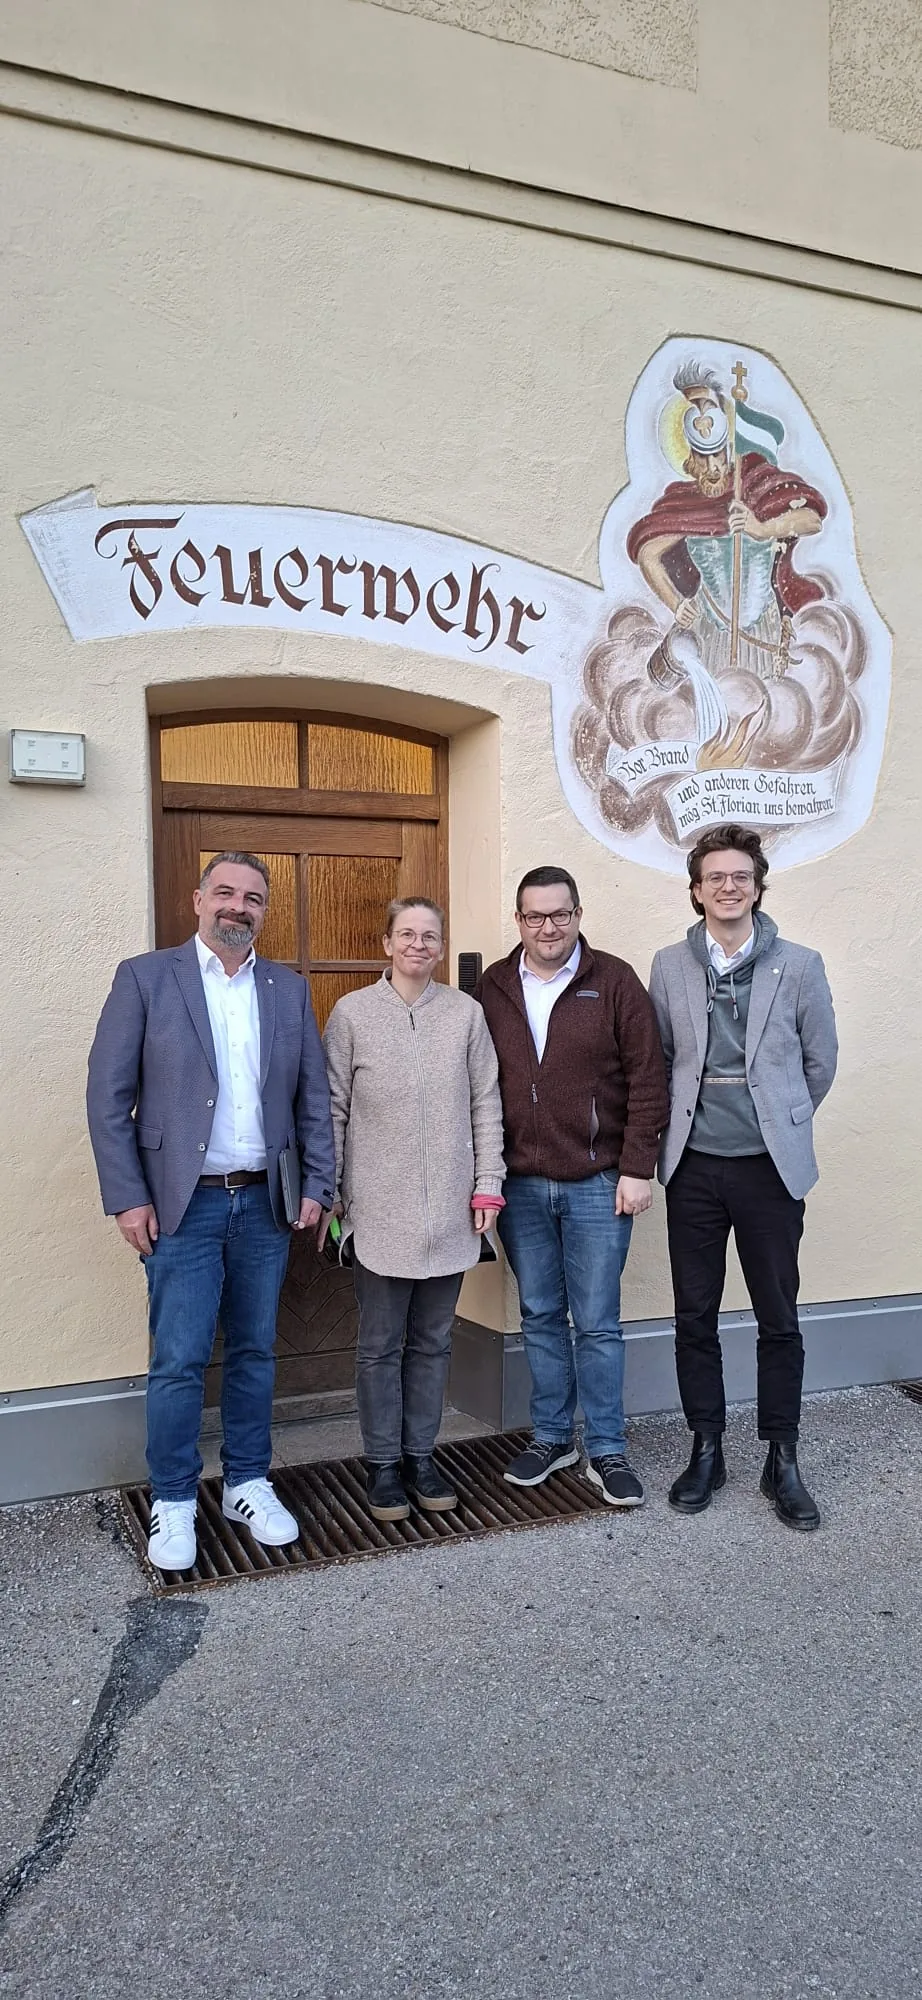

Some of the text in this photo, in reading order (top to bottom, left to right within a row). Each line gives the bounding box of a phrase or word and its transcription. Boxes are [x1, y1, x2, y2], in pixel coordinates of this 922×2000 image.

[94, 511, 547, 656] Feuerwehr
[616, 743, 690, 783] Vor Brand
[677, 772, 817, 804] und anderen Gefahren
[764, 802, 784, 816] uns
[785, 796, 834, 817] bewahren
